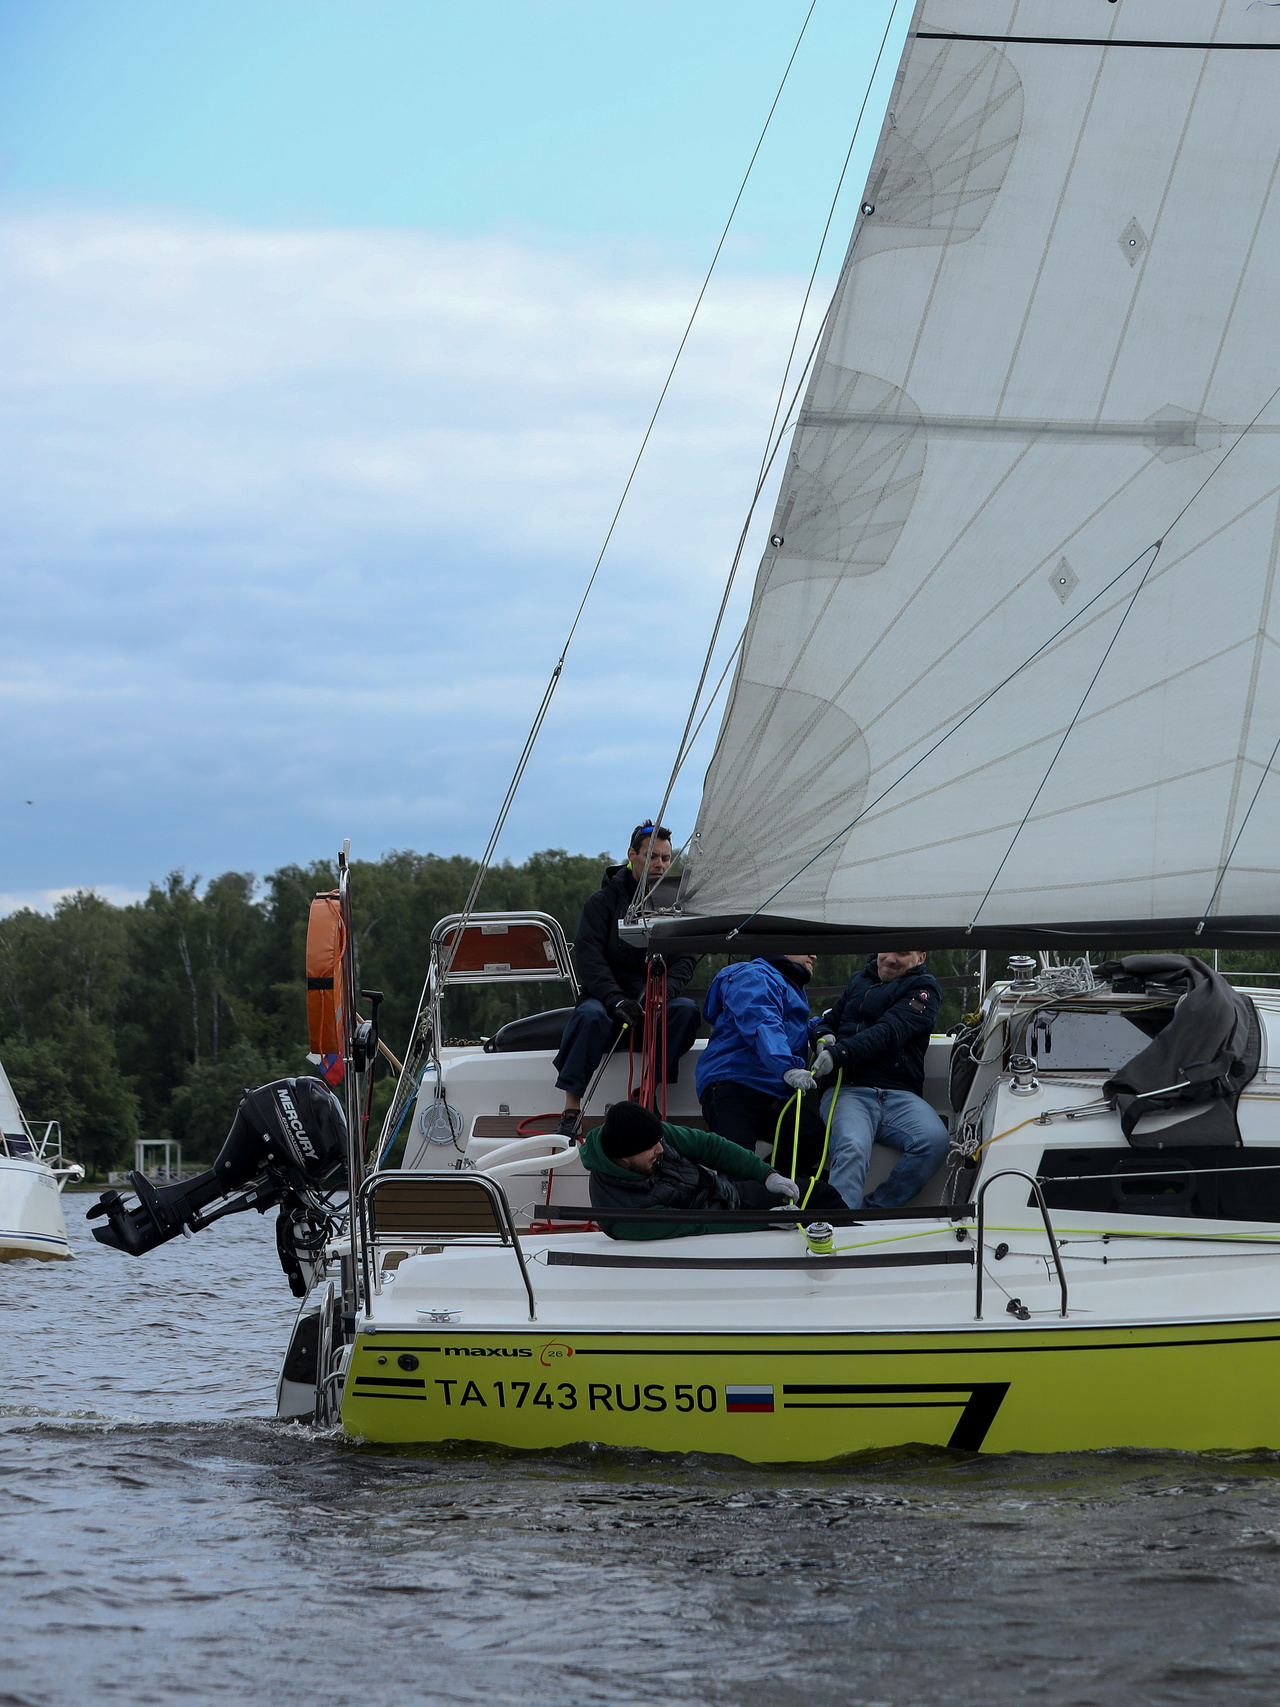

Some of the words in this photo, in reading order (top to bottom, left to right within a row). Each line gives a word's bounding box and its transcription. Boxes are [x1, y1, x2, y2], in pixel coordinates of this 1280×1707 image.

[277, 1088, 319, 1160] MERCURY
[444, 1346, 533, 1358] maxus
[547, 1350, 564, 1358] 26
[434, 1379, 488, 1407] TA
[493, 1381, 578, 1410] 1743
[588, 1383, 668, 1412] RUS
[674, 1384, 717, 1413] 50
